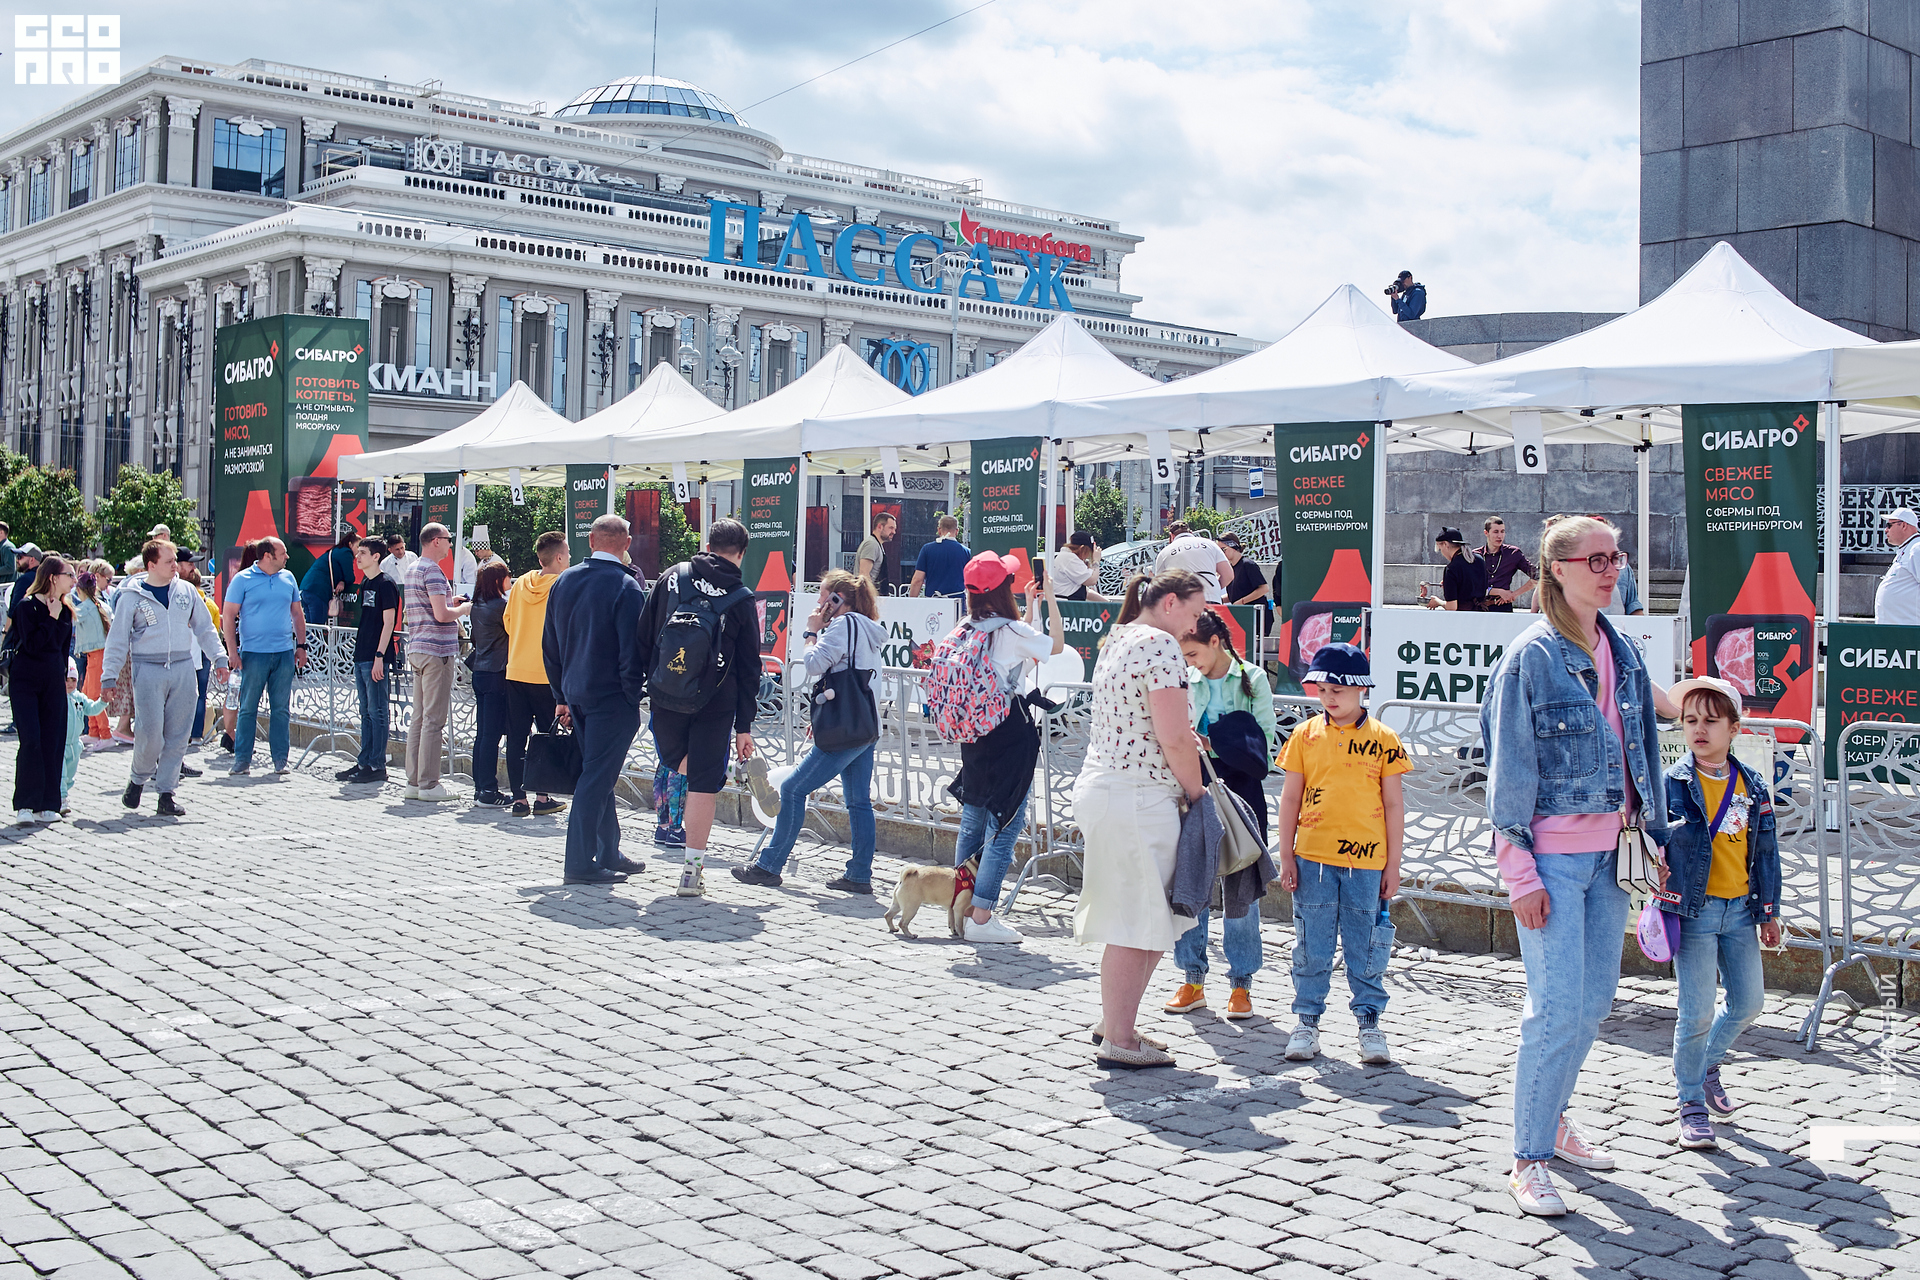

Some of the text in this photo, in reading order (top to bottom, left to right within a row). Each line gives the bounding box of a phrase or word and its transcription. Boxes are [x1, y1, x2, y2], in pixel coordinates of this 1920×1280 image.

[468, 146, 601, 184] ПАССАЖ
[494, 172, 583, 197] СИНЕМА
[976, 226, 1091, 261] гипербола
[702, 199, 1076, 312] ПАССАЖ
[295, 347, 358, 363] СИБАГРО
[224, 355, 274, 385] СИБАГРО
[296, 377, 360, 389] ГОТОВИТЬ
[296, 390, 357, 403] КОТЛЕТЫ,
[224, 402, 268, 422] ГОТОВИТЬ
[313, 404, 355, 413] ОТМЫВАТЬ
[296, 413, 328, 421] ПОЛДНЯ
[224, 425, 251, 441] МЯСО,
[296, 423, 341, 431] МЯСОРУБКУ
[1701, 427, 1798, 451] СИБАГРО
[224, 443, 273, 459] А НЕ ЗАНИМАТЬСЯ
[1289, 443, 1362, 463] СИБАГРО
[1522, 444, 1539, 468] 6
[224, 459, 265, 475] РАЗМОРОЗКОЙ
[982, 457, 1033, 475] СИБАГРО
[1157, 458, 1169, 479] 5
[751, 472, 792, 487] СИБАГРО
[889, 471, 898, 489] 4
[1704, 465, 1773, 482] СВЕЖЕЕ
[573, 478, 606, 491] СИБАГРО
[1293, 475, 1345, 490] СВЕЖЕЕ
[429, 485, 457, 497] СИБАГРО
[514, 487, 520, 502] 2
[678, 483, 686, 498] 3
[983, 485, 1021, 497] СВЕЖЕЕ
[1706, 486, 1755, 502] МЯСО
[377, 494, 382, 506] 1
[575, 500, 598, 509] СВЕЖЕЕ
[751, 496, 781, 507] СВЕЖЕЕ
[983, 499, 1010, 512] МЯСО
[1294, 492, 1332, 506] МЯСО
[429, 504, 448, 512] СВЕЖЕЕ
[751, 509, 771, 519] МЯСО
[1295, 510, 1353, 520] С ФЕРМЫ ПОД
[1706, 506, 1780, 517] С ФЕРМЫ ПОД
[575, 512, 592, 520] МЯСО
[983, 514, 1023, 524] С ФЕРМЫ ПОД
[771, 521, 783, 529] ПОД
[983, 524, 1034, 534] ЕКАТЕРИНБУРГОМ
[1295, 521, 1368, 532] ЕКАТЕРИНБУРГОМ
[1706, 520, 1803, 532] ЕКАТЕРИНБУРГОМ
[1045, 617, 1103, 634] СБАГРО
[1334, 616, 1361, 624] СИБАГРО
[1757, 632, 1792, 640] СИБАГРО
[1398, 641, 1504, 667] ФЕСТИ
[1839, 647, 1920, 669] СИБАГ
[1345, 674, 1375, 686] PUM
